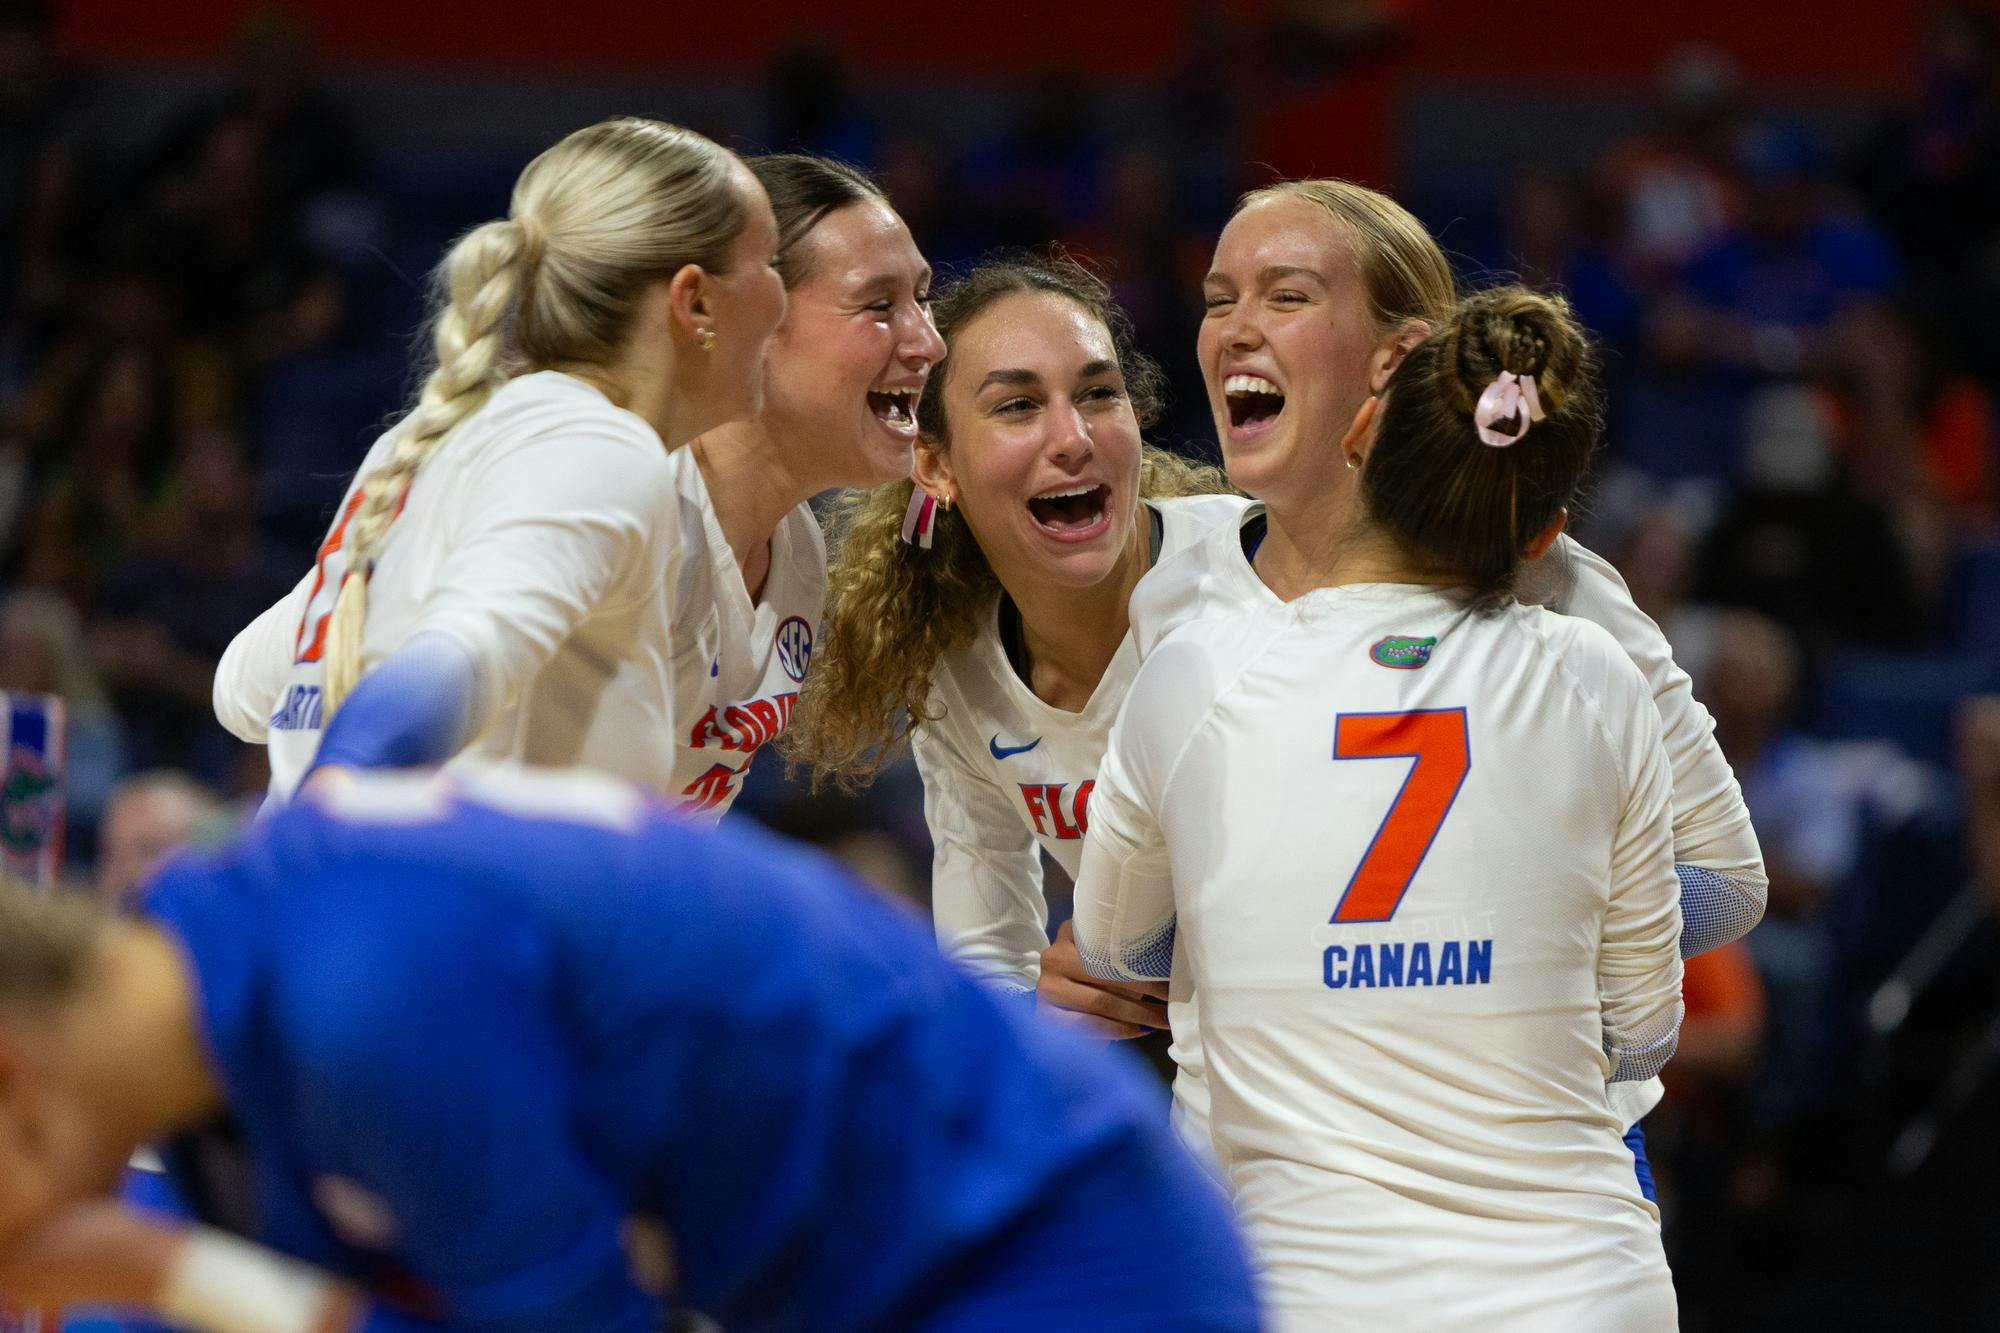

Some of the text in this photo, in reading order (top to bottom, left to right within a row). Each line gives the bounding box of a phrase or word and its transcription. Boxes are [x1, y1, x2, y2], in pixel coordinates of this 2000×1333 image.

[690, 692, 798, 753] FLORI
[1329, 706, 1471, 924] 7
[1323, 939, 1493, 989] CANAAN
